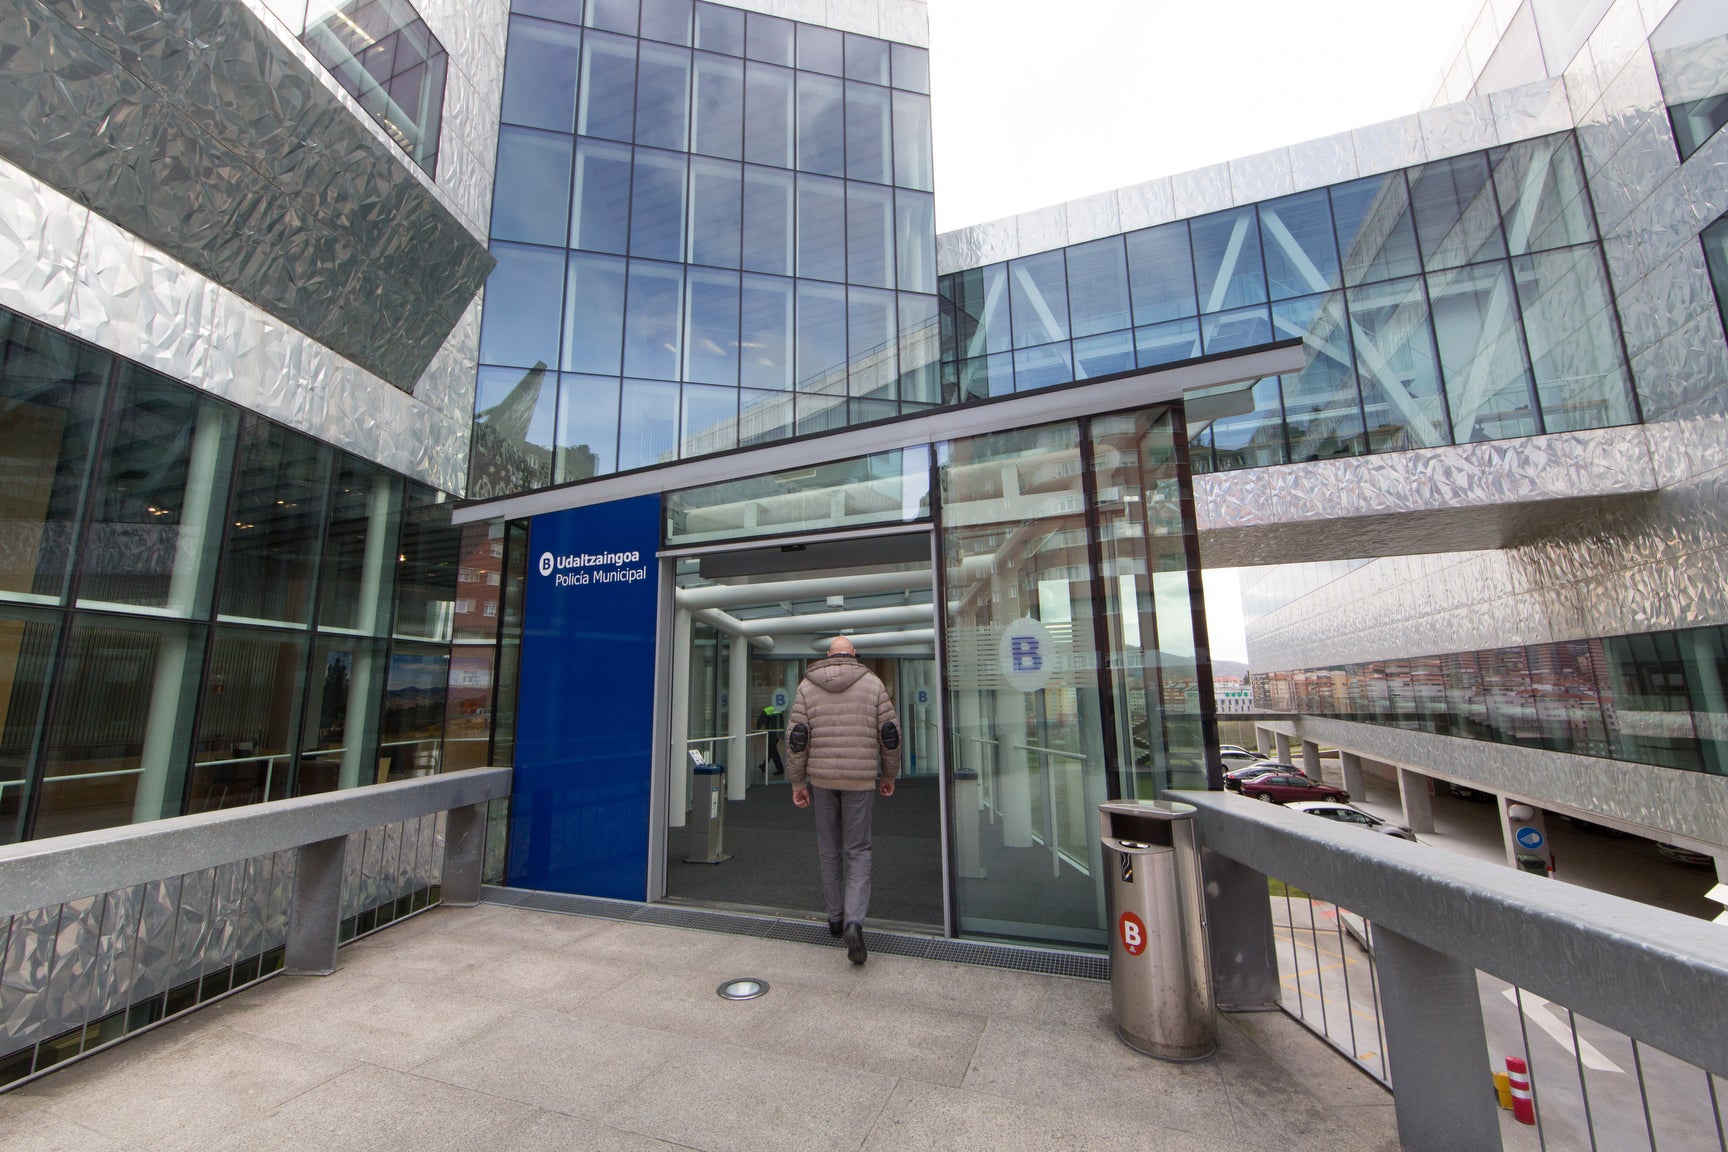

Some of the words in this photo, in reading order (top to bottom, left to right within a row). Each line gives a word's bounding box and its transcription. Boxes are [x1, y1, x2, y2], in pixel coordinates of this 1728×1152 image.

[556, 551, 640, 569] Udaltzaingoa
[555, 570, 590, 587] Policía
[593, 565, 647, 584] Municipal
[1011, 636, 1044, 671] B
[1124, 920, 1142, 946] B
